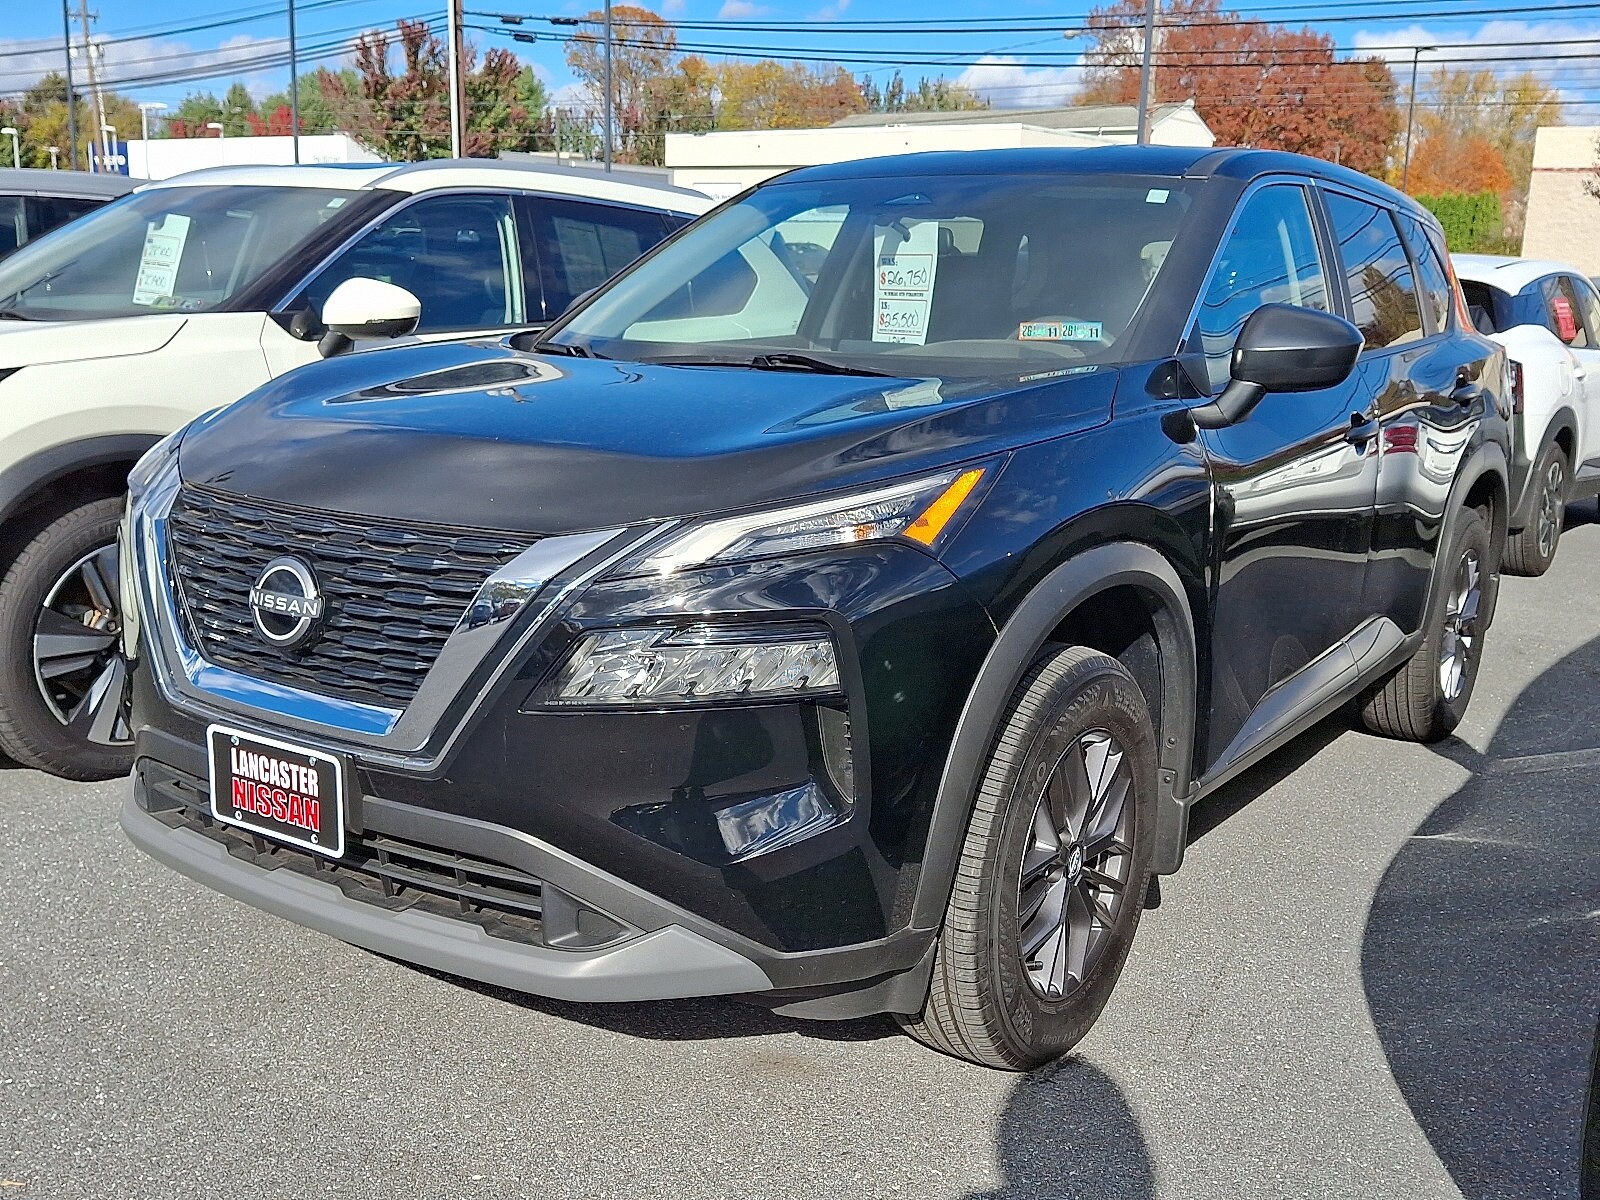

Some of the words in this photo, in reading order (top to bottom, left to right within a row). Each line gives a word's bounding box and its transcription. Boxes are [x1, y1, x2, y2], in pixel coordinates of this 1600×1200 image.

[1048, 327, 1057, 337] 11
[1089, 327, 1099, 338] 11
[250, 588, 318, 616] NISSAN
[231, 747, 318, 798] LANCASTER
[232, 776, 320, 832] NISSAN
